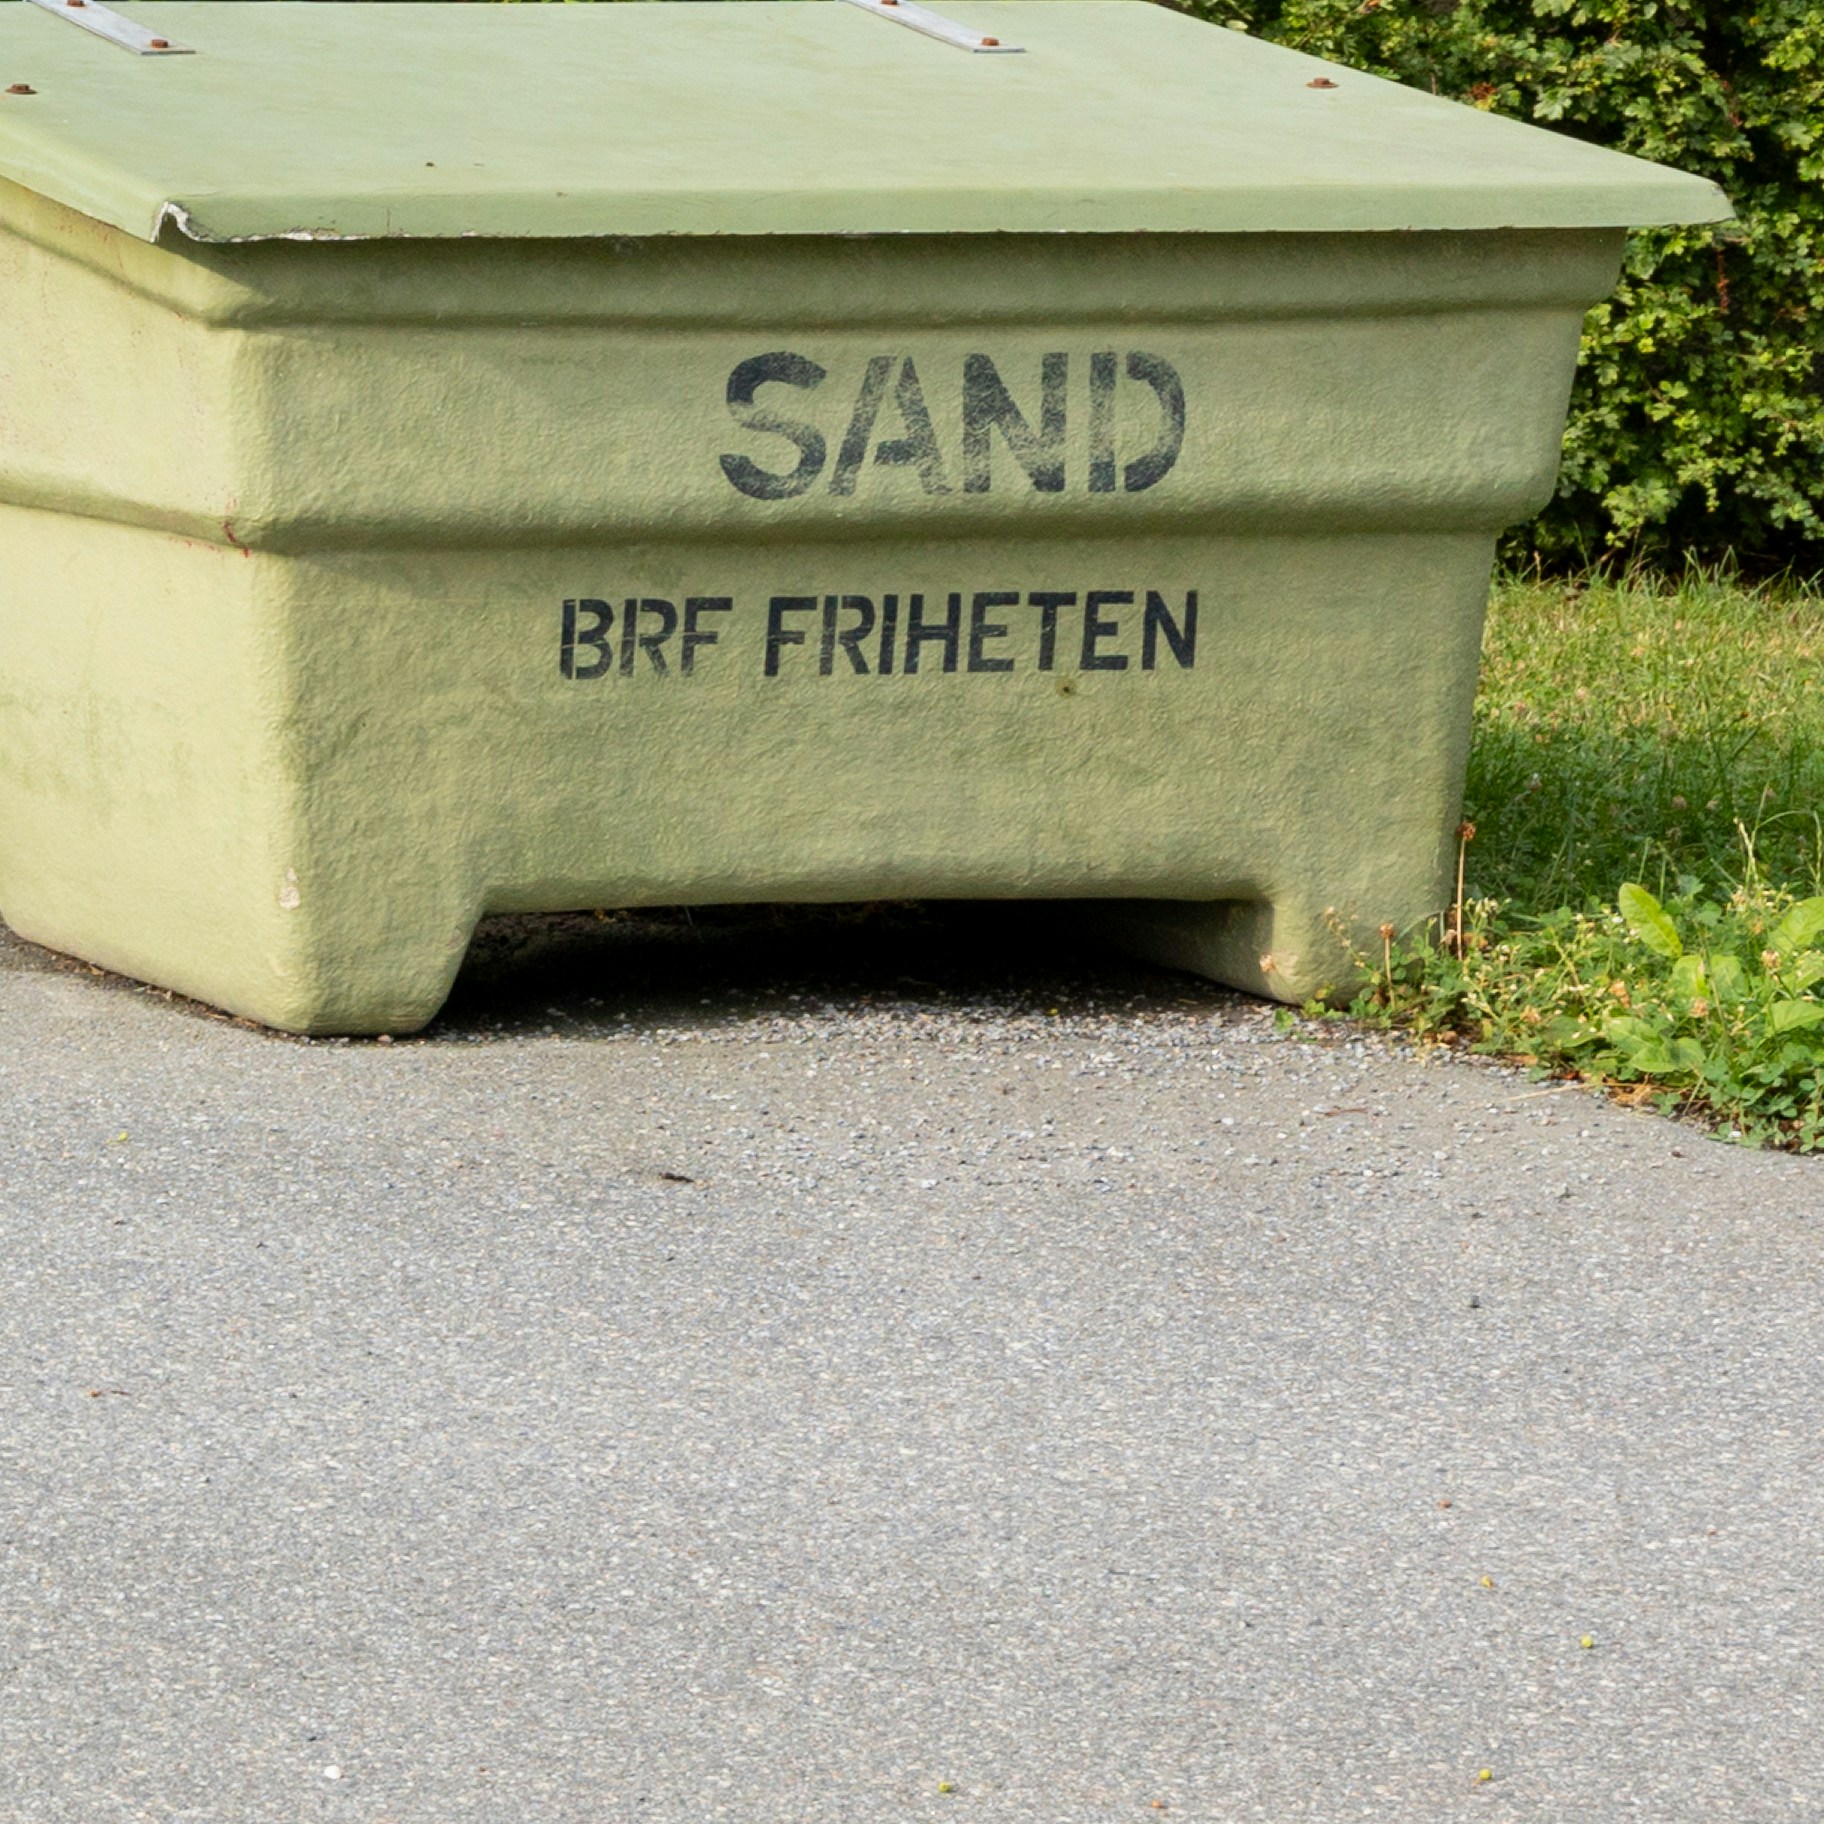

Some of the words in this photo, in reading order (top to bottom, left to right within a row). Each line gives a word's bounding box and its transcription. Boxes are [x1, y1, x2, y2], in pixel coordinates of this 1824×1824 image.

[719, 350, 1186, 501] SAND
[560, 597, 732, 679] BRF
[764, 590, 1199, 678] FRIHETEN
